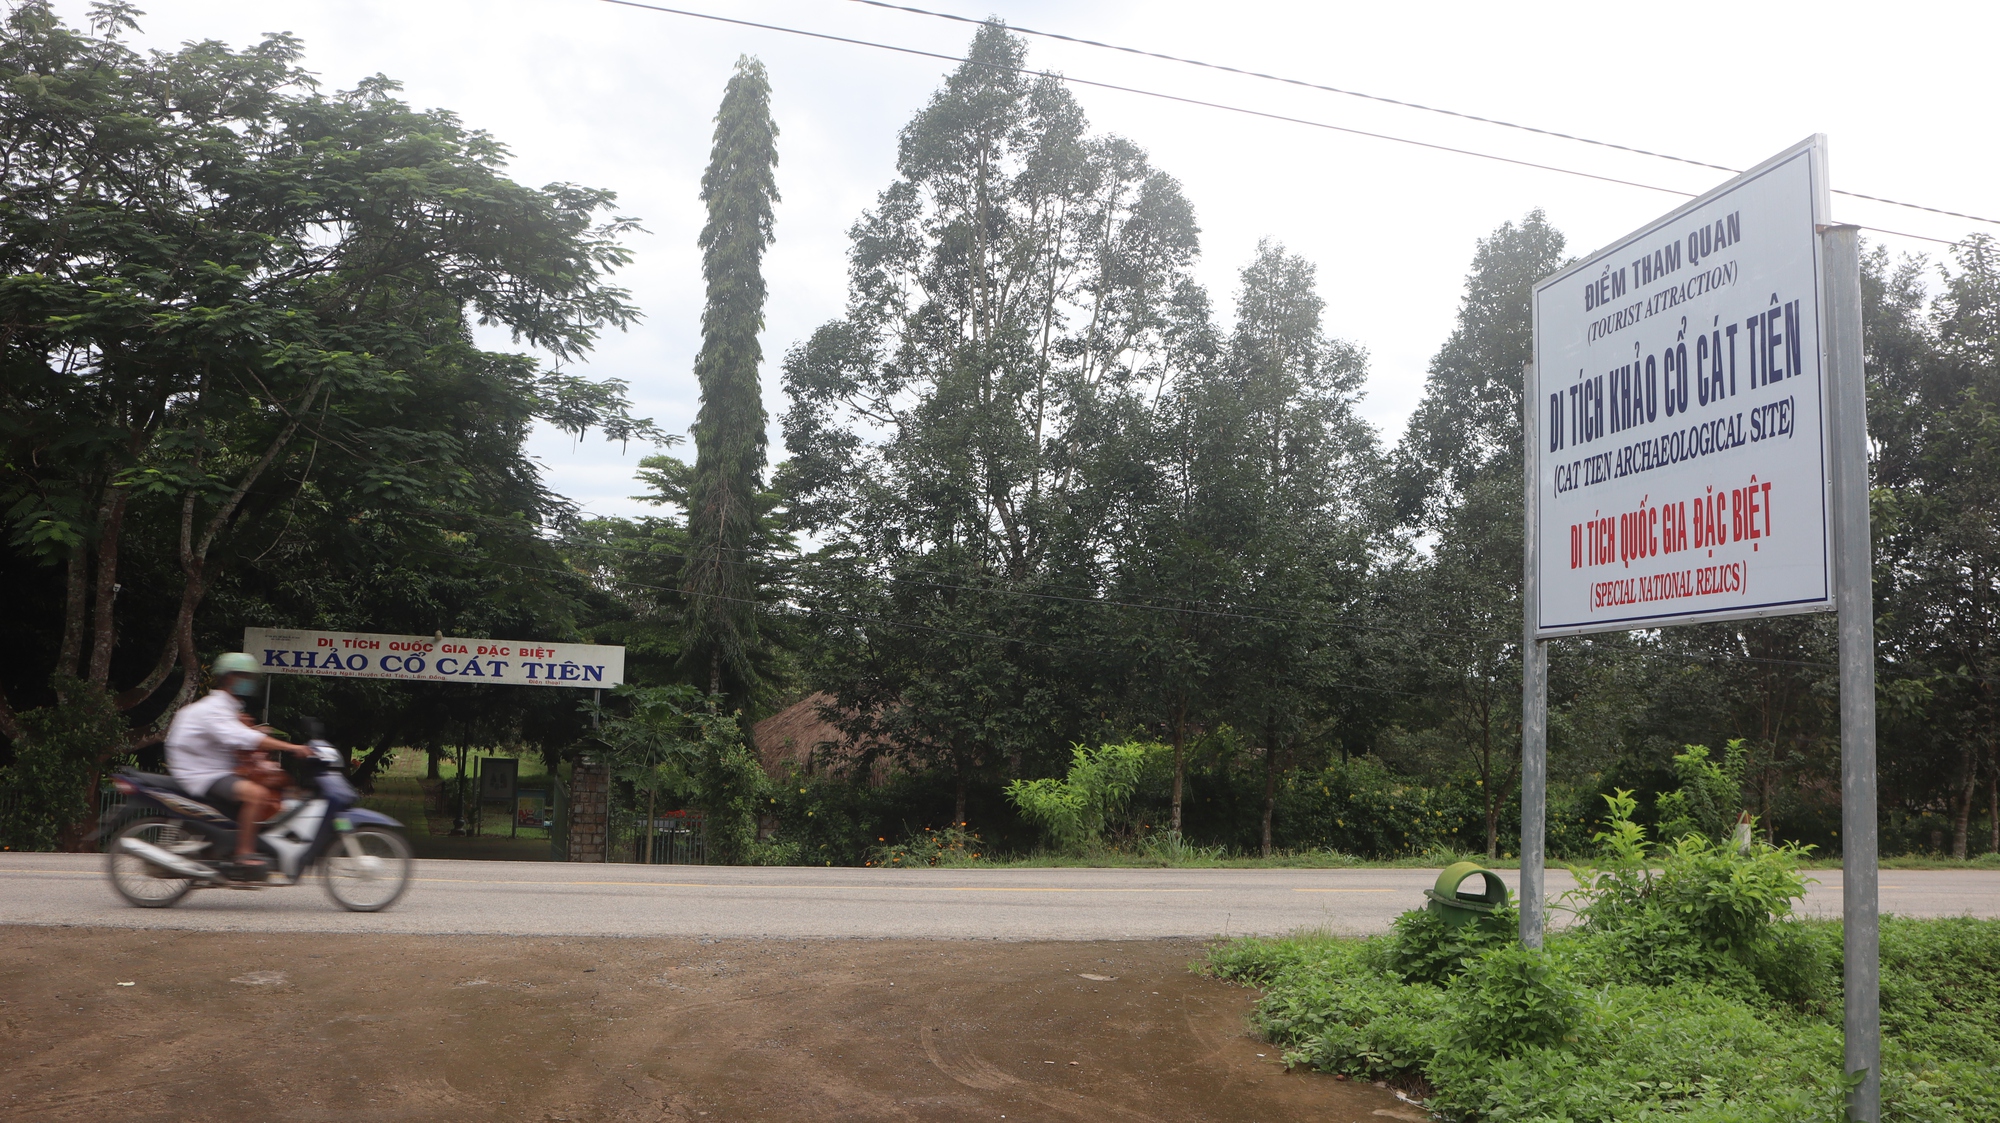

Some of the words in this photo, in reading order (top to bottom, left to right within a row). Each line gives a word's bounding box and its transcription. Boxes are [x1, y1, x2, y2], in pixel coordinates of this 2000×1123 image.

[1585, 264, 1626, 312] ĐIỂM
[1632, 239, 1681, 289] THAM
[1688, 210, 1741, 267] QUAN
[1587, 300, 1643, 347] (TOURIST
[1644, 259, 1738, 318] ATTRACTION)
[1550, 390, 1564, 453] DI
[1570, 368, 1604, 446] TÍCH
[1609, 341, 1657, 434] KHẢO
[1664, 315, 1688, 418] CỔ
[1696, 314, 1738, 407] CÁT
[1746, 292, 1802, 390] TIÊN
[1553, 460, 1581, 498] (CAT
[1583, 451, 1612, 487] TIEN
[1614, 412, 1747, 479] ARCHAEOLOGICAL
[1749, 395, 1795, 443] SITE)
[1570, 523, 1582, 570] DI
[1587, 509, 1615, 567] TÍCH
[1620, 494, 1657, 569] QUỐC
[1662, 501, 1688, 555] GIA
[1693, 485, 1727, 558] ĐẶC
[1732, 474, 1772, 552] BIỆT
[1638, 570, 1694, 603] NATIONAL
[262, 647, 369, 671] KHẢO
[379, 651, 427, 674] CỔ
[435, 655, 509, 678] CÁT
[521, 660, 605, 682] TIÊN
[317, 637, 333, 647] DI
[342, 637, 380, 650] TÍCH
[388, 639, 434, 652] QUỐC
[441, 643, 468, 654] GIA
[477, 644, 511, 658] ĐẶC
[519, 646, 556, 660] BIỆT
